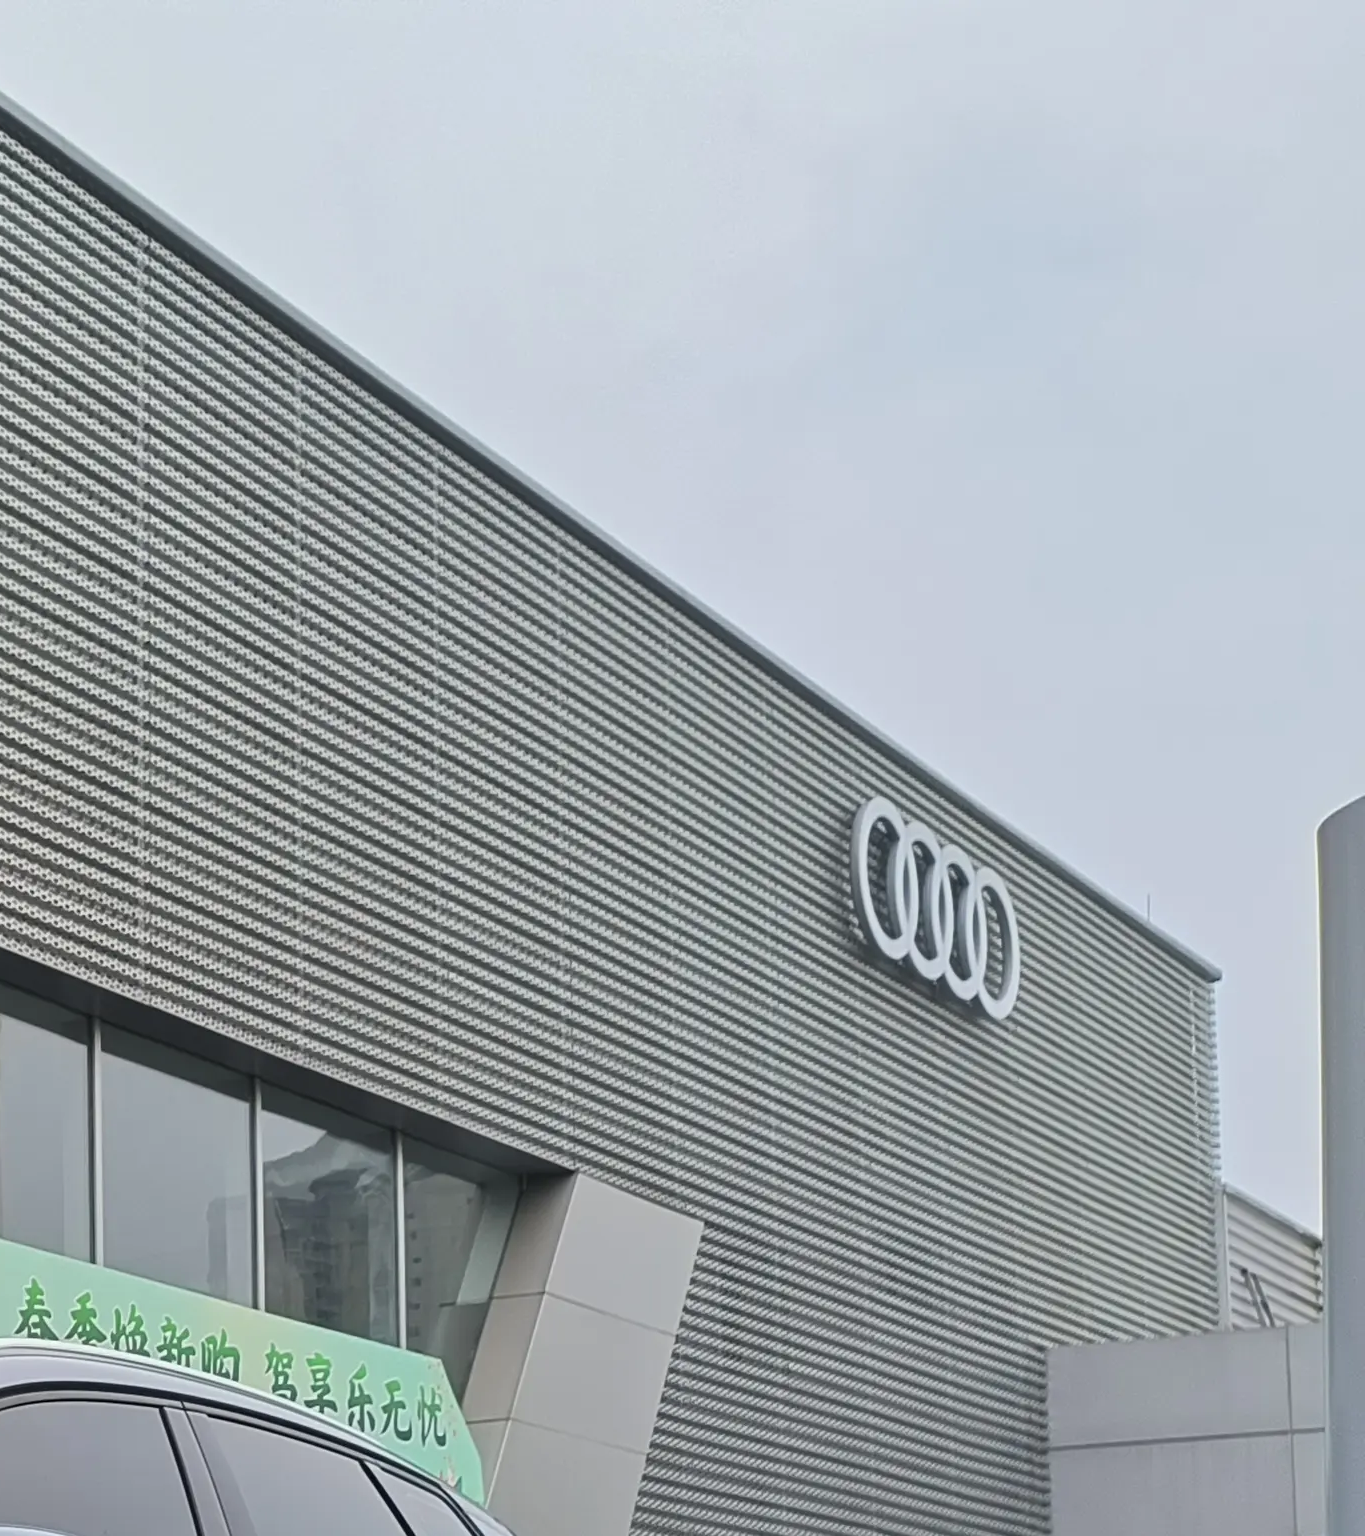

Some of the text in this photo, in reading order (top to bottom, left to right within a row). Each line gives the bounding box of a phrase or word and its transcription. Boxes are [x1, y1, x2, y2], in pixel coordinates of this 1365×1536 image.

[264, 1341, 448, 1448] 驾享乐无忧
